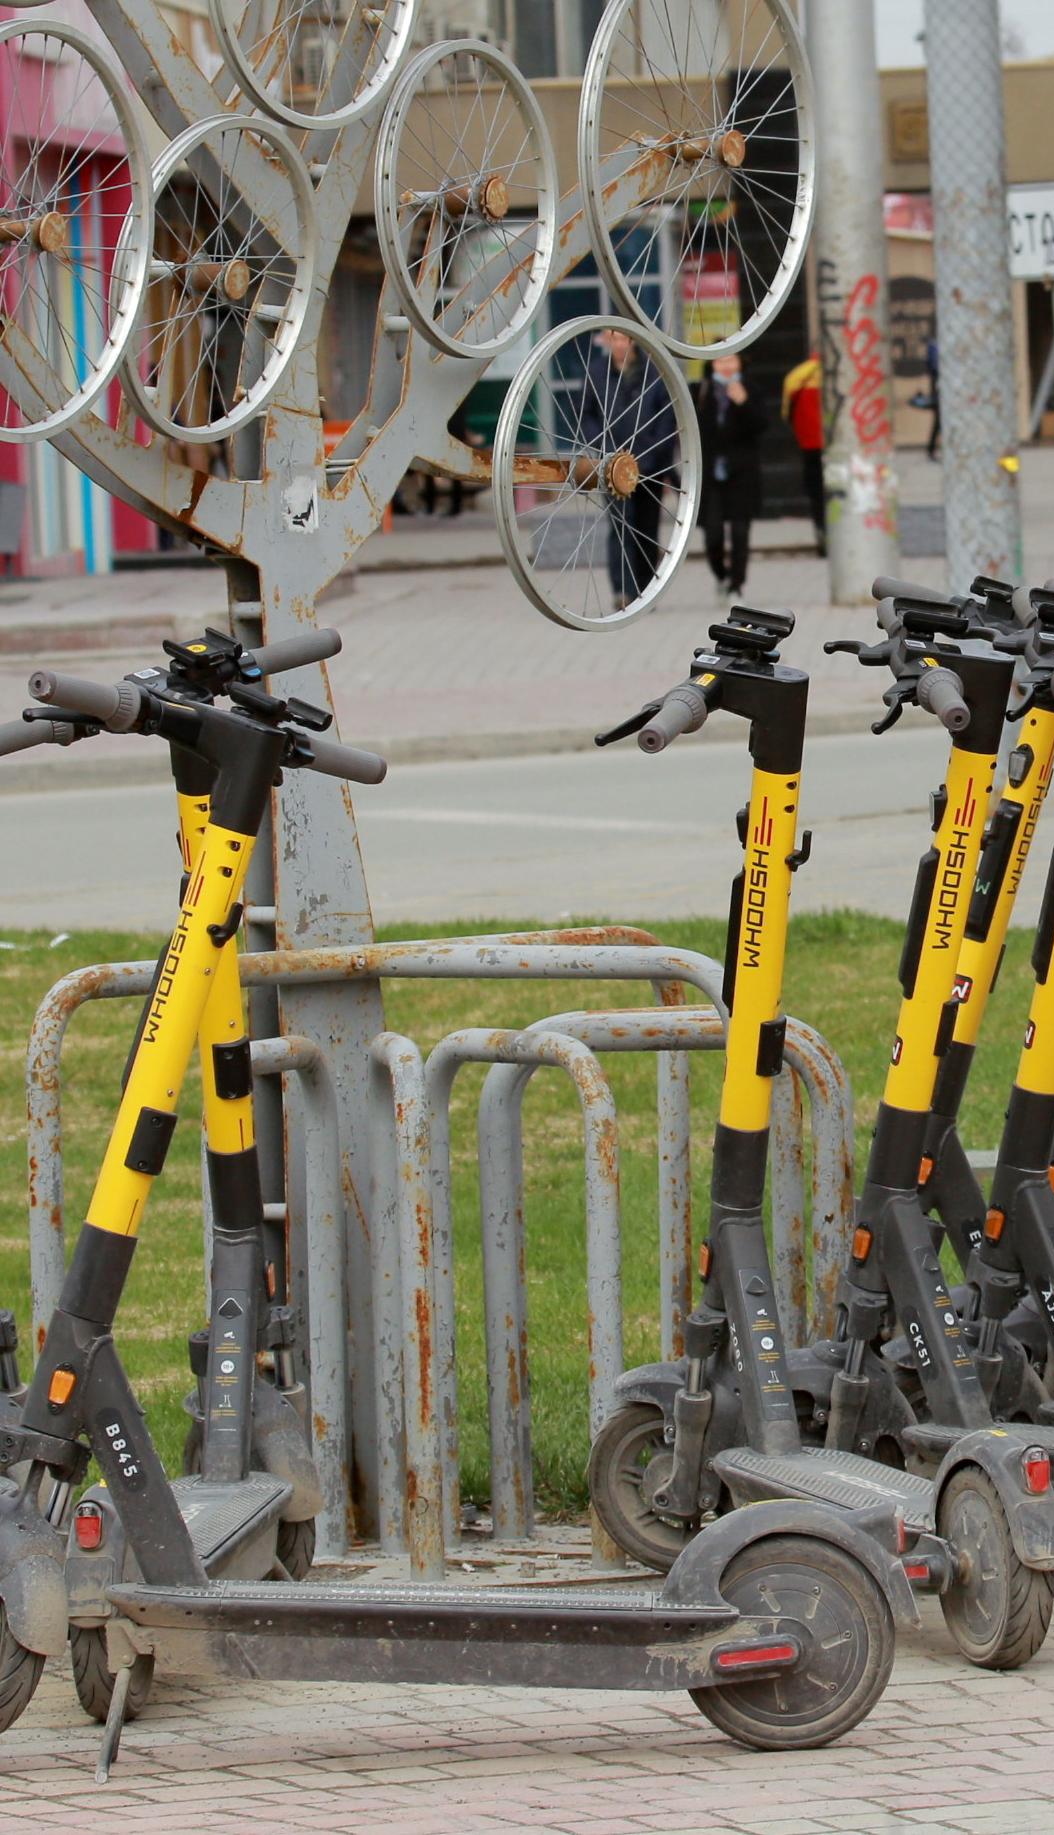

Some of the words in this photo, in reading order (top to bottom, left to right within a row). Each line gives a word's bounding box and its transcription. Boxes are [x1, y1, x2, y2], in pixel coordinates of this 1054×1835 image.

[932, 830, 969, 949] WHOOSH
[1007, 785, 1045, 894] WHOOSH
[743, 849, 769, 967] WHOOSH
[143, 910, 193, 1043] WHOOSH
[909, 1322, 931, 1367] CK51
[105, 1423, 138, 1477] B845
